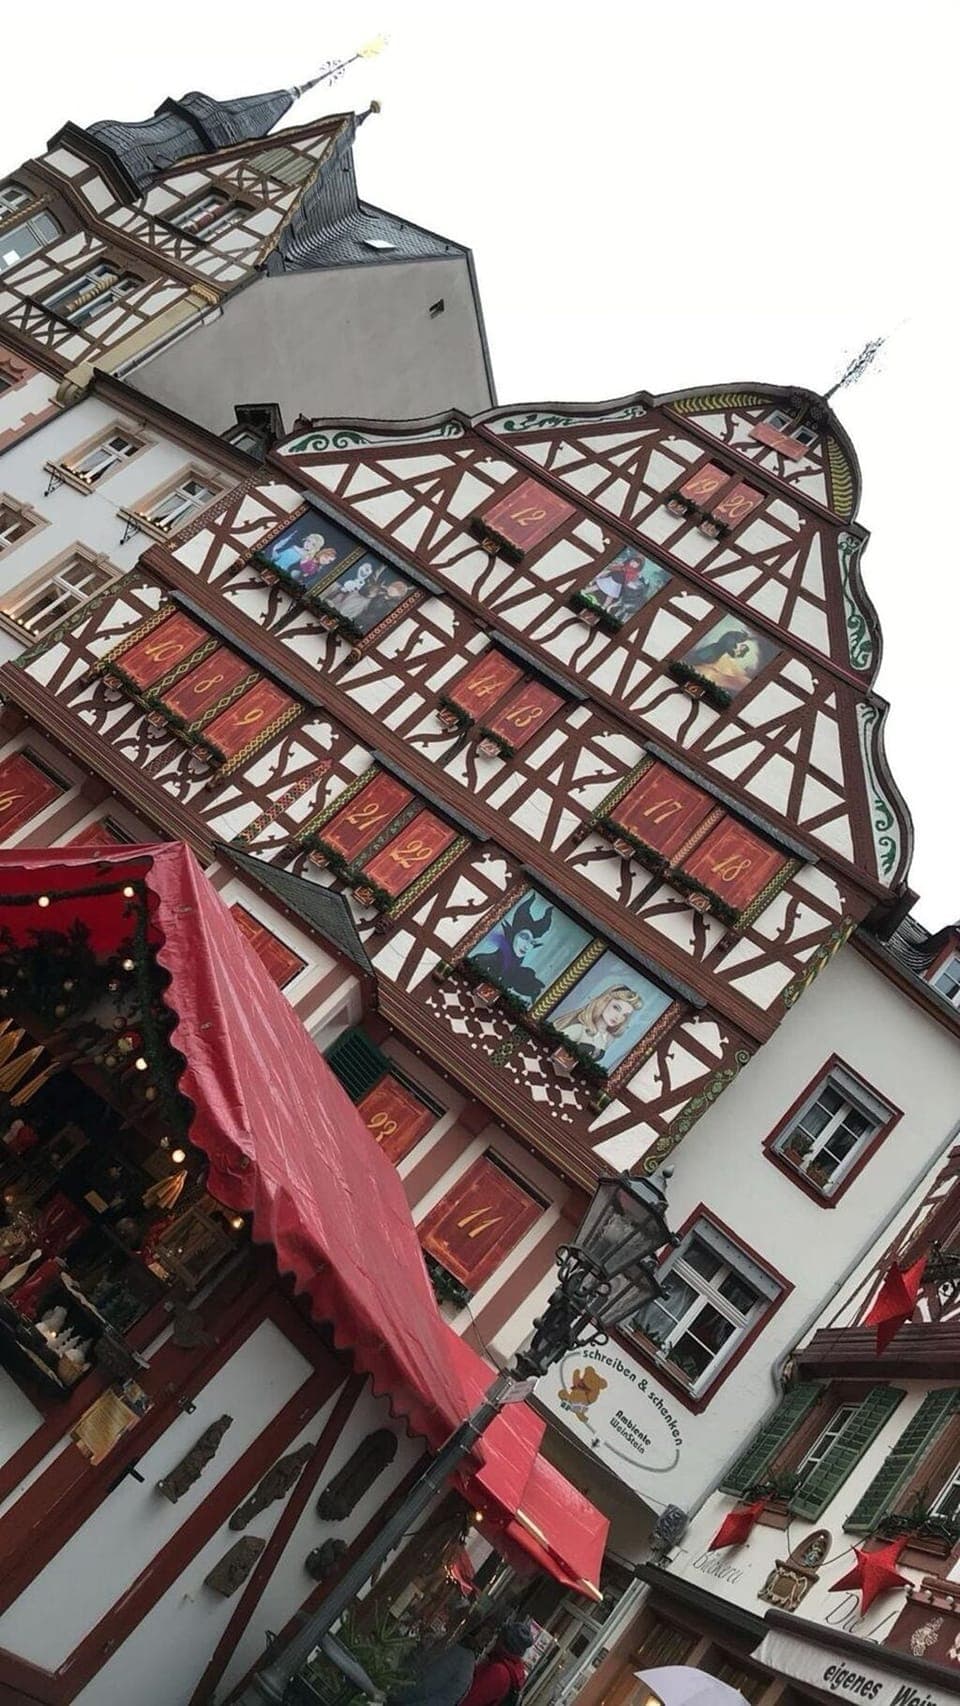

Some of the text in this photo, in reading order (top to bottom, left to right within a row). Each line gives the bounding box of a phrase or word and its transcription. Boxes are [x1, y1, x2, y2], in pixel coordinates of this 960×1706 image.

[687, 479, 719, 495] 19
[509, 506, 546, 527] 12
[718, 495, 754, 518] 20
[144, 640, 184, 663] 10
[194, 674, 225, 694] 8
[467, 674, 505, 698] 14
[233, 708, 265, 727] 9
[506, 704, 544, 728] 13
[345, 802, 390, 832] 21
[643, 798, 683, 825] 17
[389, 840, 433, 869] 22
[711, 854, 752, 882] 18
[457, 1206, 503, 1239] 11
[583, 1349, 683, 1446] schreiben & schenken
[609, 1417, 645, 1454] WeinStein
[615, 1410, 652, 1446] Ambiente
[823, 1662, 883, 1700] eigenes
